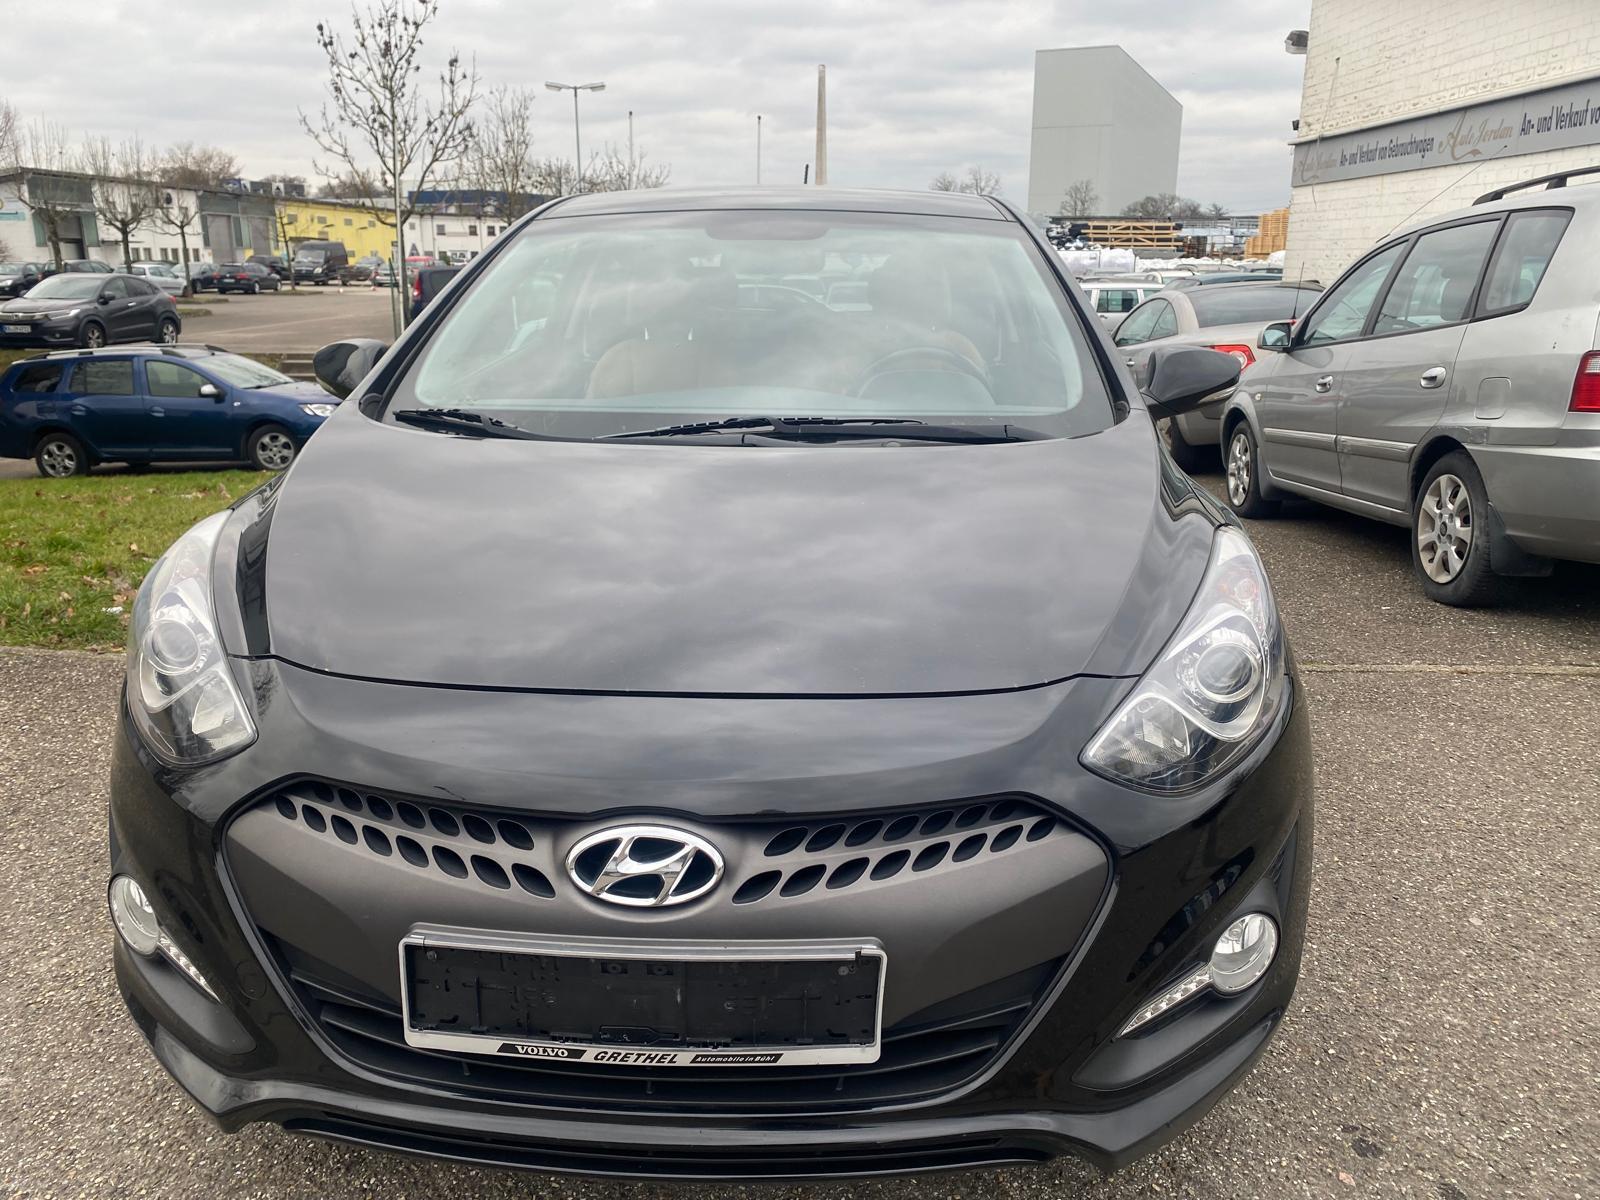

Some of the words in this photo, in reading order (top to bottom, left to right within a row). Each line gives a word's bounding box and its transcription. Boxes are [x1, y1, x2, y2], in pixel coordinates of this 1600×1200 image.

[1520, 112, 1534, 136] An-
[1537, 106, 1554, 132] und
[1555, 98, 1590, 130] Verkauf
[1348, 144, 1359, 165] und
[1359, 140, 1379, 163] Verkauf
[1387, 133, 1435, 159] Gebrauchtwagen
[514, 1045, 569, 1058] VOLVO
[593, 1050, 678, 1064] GRETHEL
[696, 1055, 744, 1063] Automobile
